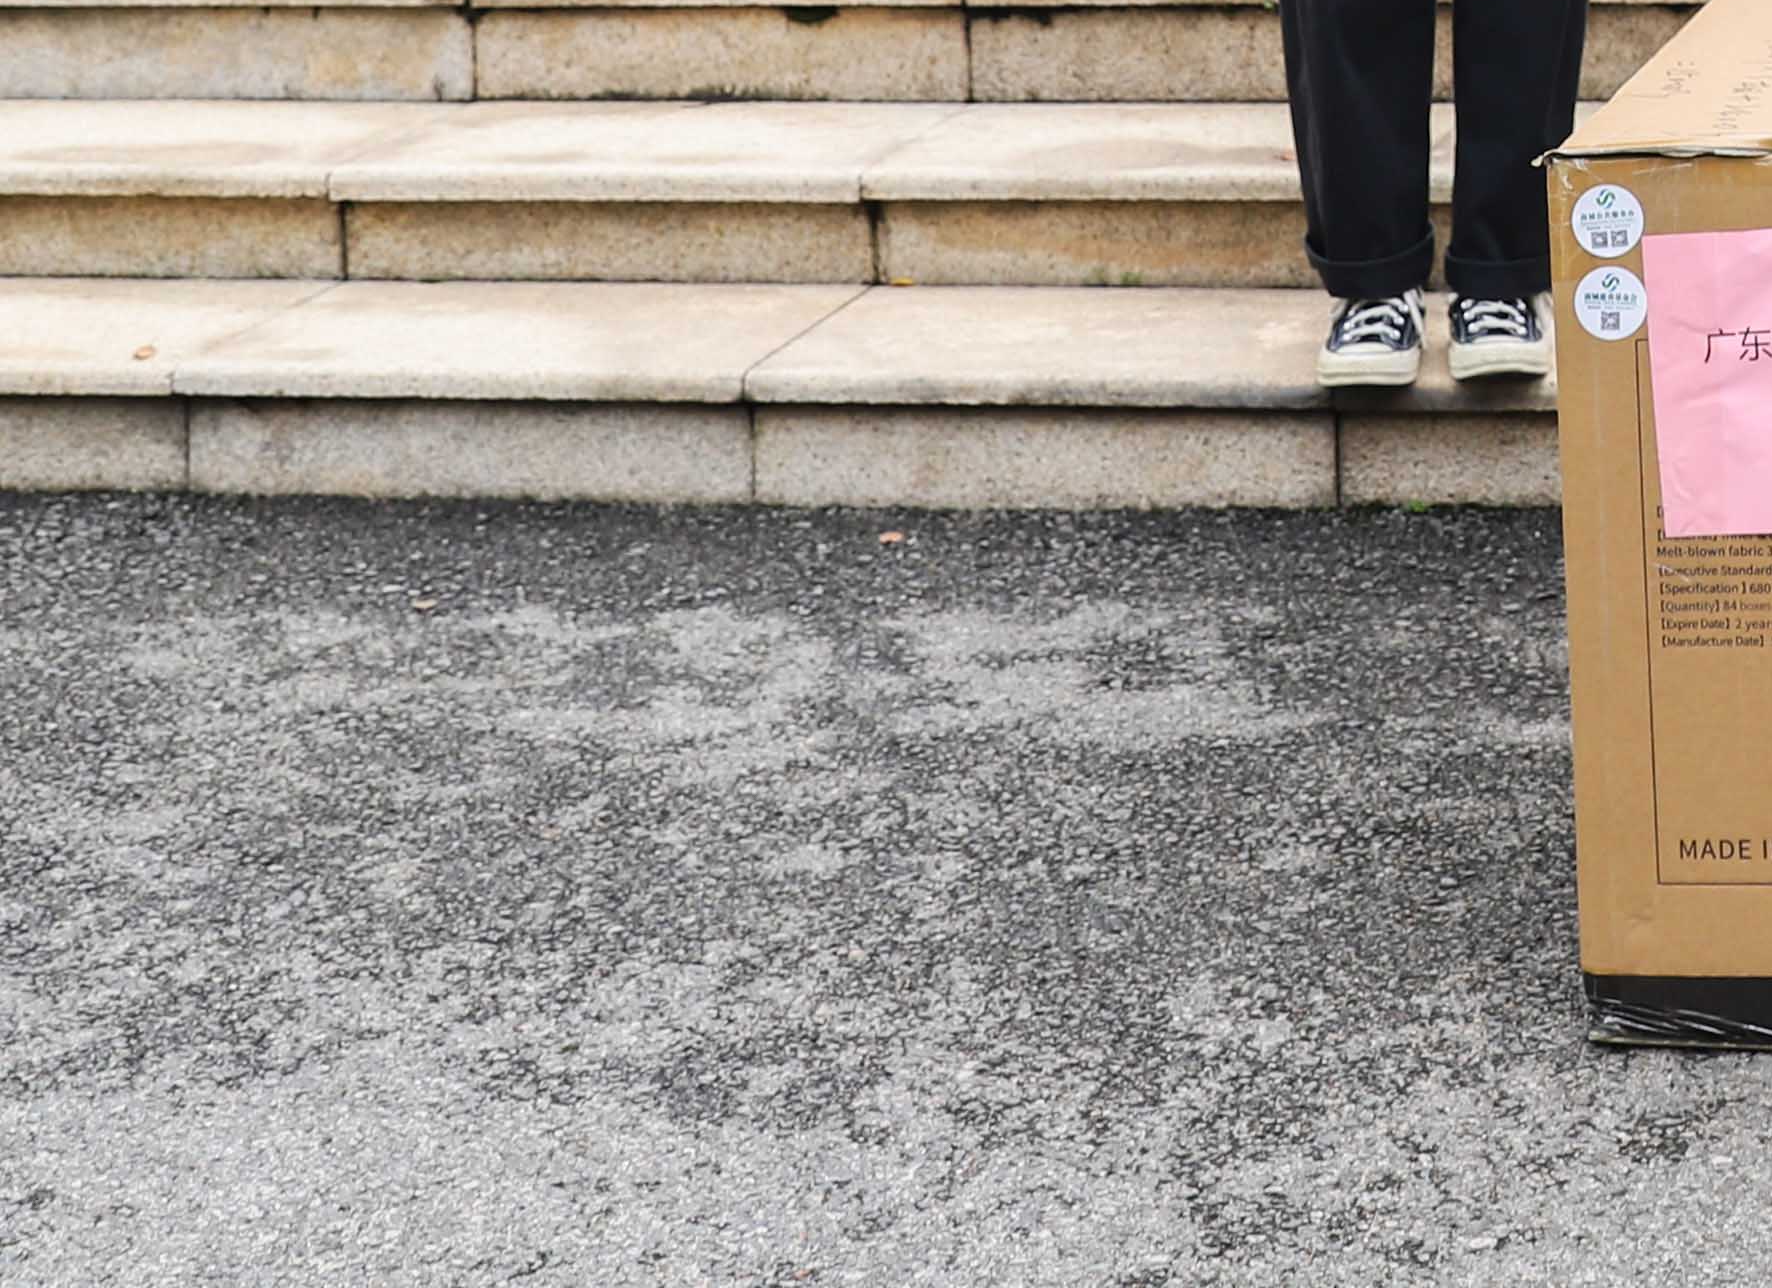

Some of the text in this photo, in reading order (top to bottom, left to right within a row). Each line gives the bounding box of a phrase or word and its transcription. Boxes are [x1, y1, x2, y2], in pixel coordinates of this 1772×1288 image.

[1657, 544, 1725, 558] Melt-blown
[1728, 543, 1764, 557] fabric
[1739, 601, 1772, 612] boxes
[1735, 619, 1742, 630] 2
[1679, 838, 1752, 860] MADE
